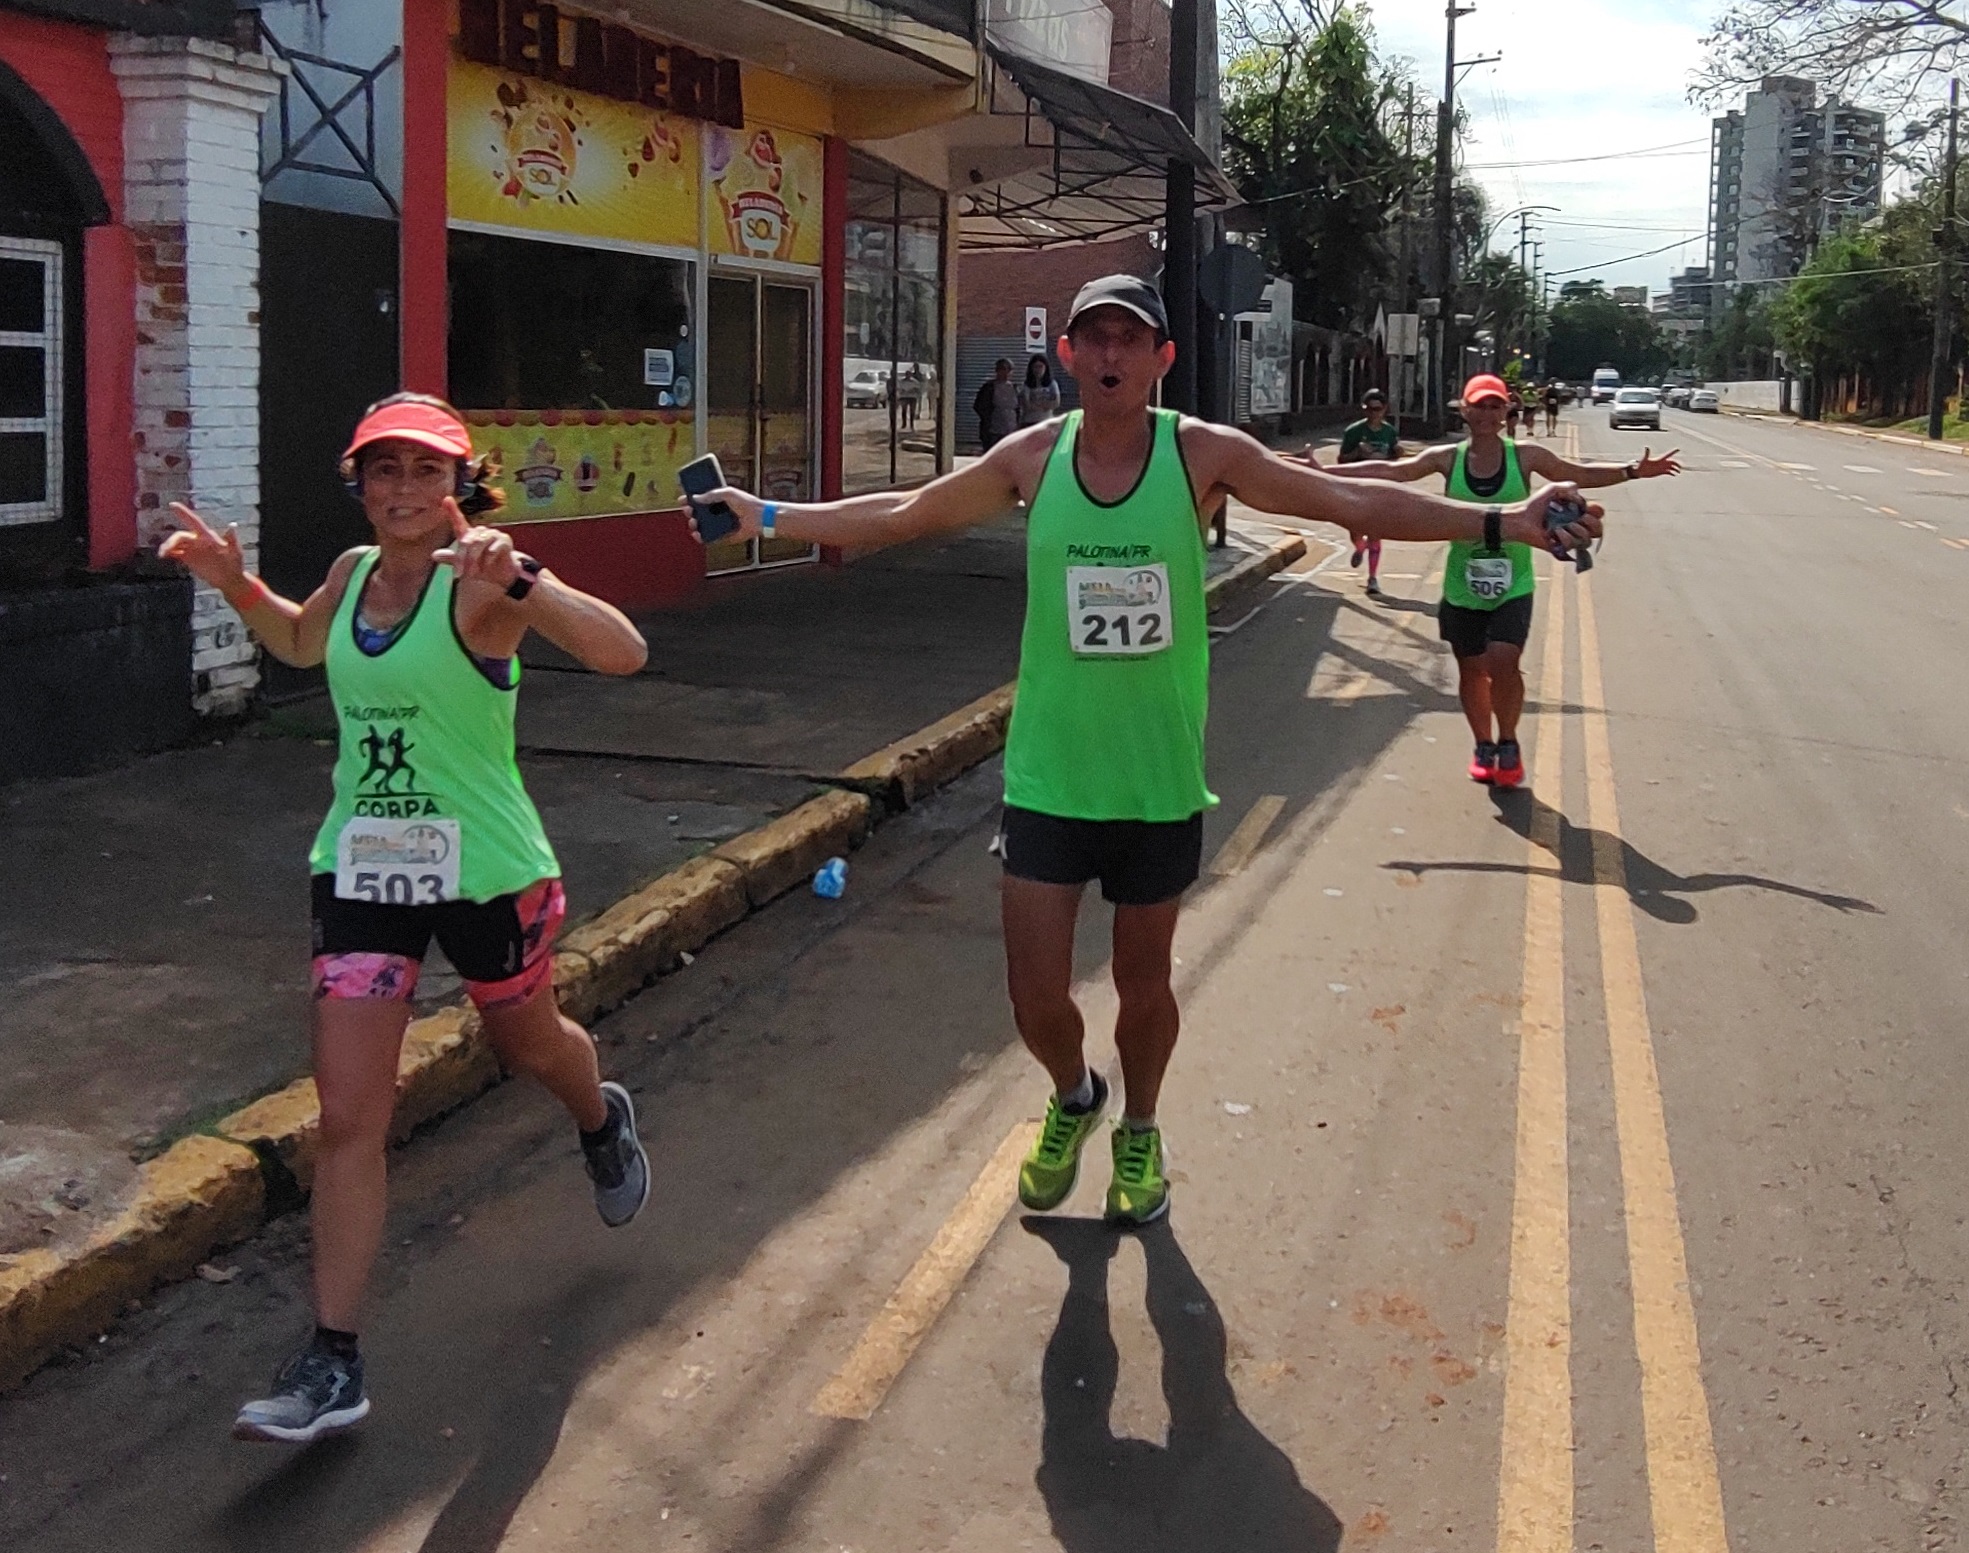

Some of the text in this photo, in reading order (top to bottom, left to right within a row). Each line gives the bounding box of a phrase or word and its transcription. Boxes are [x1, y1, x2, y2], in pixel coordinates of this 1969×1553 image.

[529, 167, 558, 186] SOL
[746, 216, 779, 241] SOL
[1066, 544, 1152, 558] PALOTINA/PR
[1471, 580, 1507, 597] 506
[1082, 613, 1163, 646] 212
[354, 798, 441, 818] CORPA
[353, 871, 448, 905] 503
